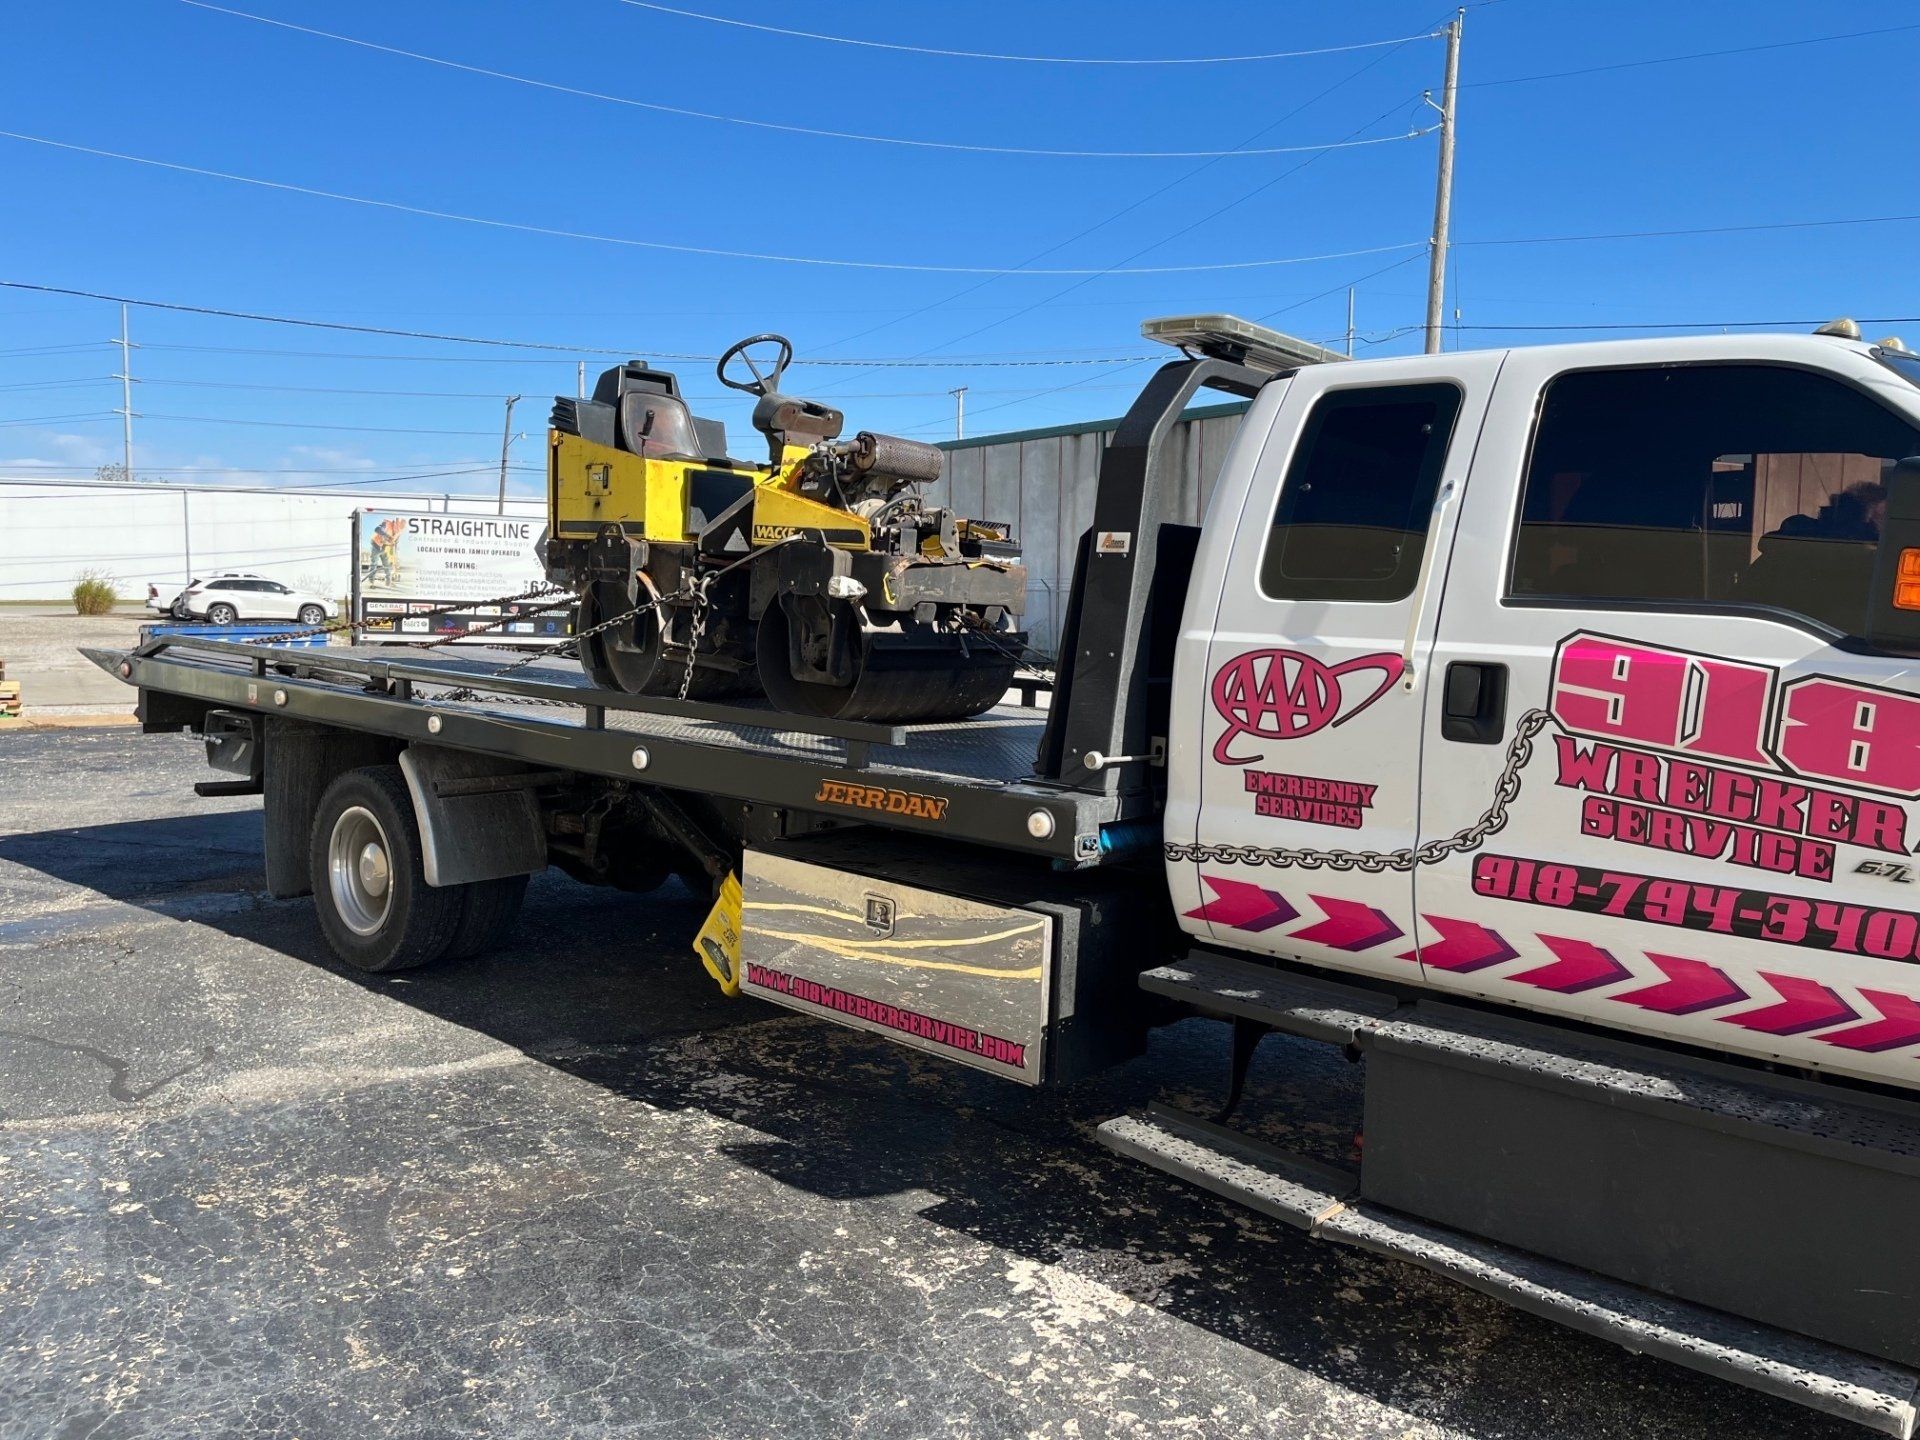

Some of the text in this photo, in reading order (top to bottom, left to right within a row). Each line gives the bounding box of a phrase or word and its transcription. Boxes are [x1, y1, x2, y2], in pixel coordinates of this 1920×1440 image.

[408, 517, 530, 539] STRAIGHTLINE
[468, 548, 489, 556] FAMILY
[490, 549, 521, 557] OPERATED
[756, 525, 796, 539] WACKE
[1225, 652, 1326, 735] AAA
[1548, 628, 1920, 800] 918
[1244, 769, 1379, 809] EMERGENCY
[1255, 792, 1364, 830] SERVICES
[1553, 733, 1912, 857] WRECKER
[1581, 794, 1836, 883] SERVICE
[1472, 853, 1920, 964] 918-794-340
[747, 962, 1027, 1069] WWW.918WRECKERSERVICE.COM
